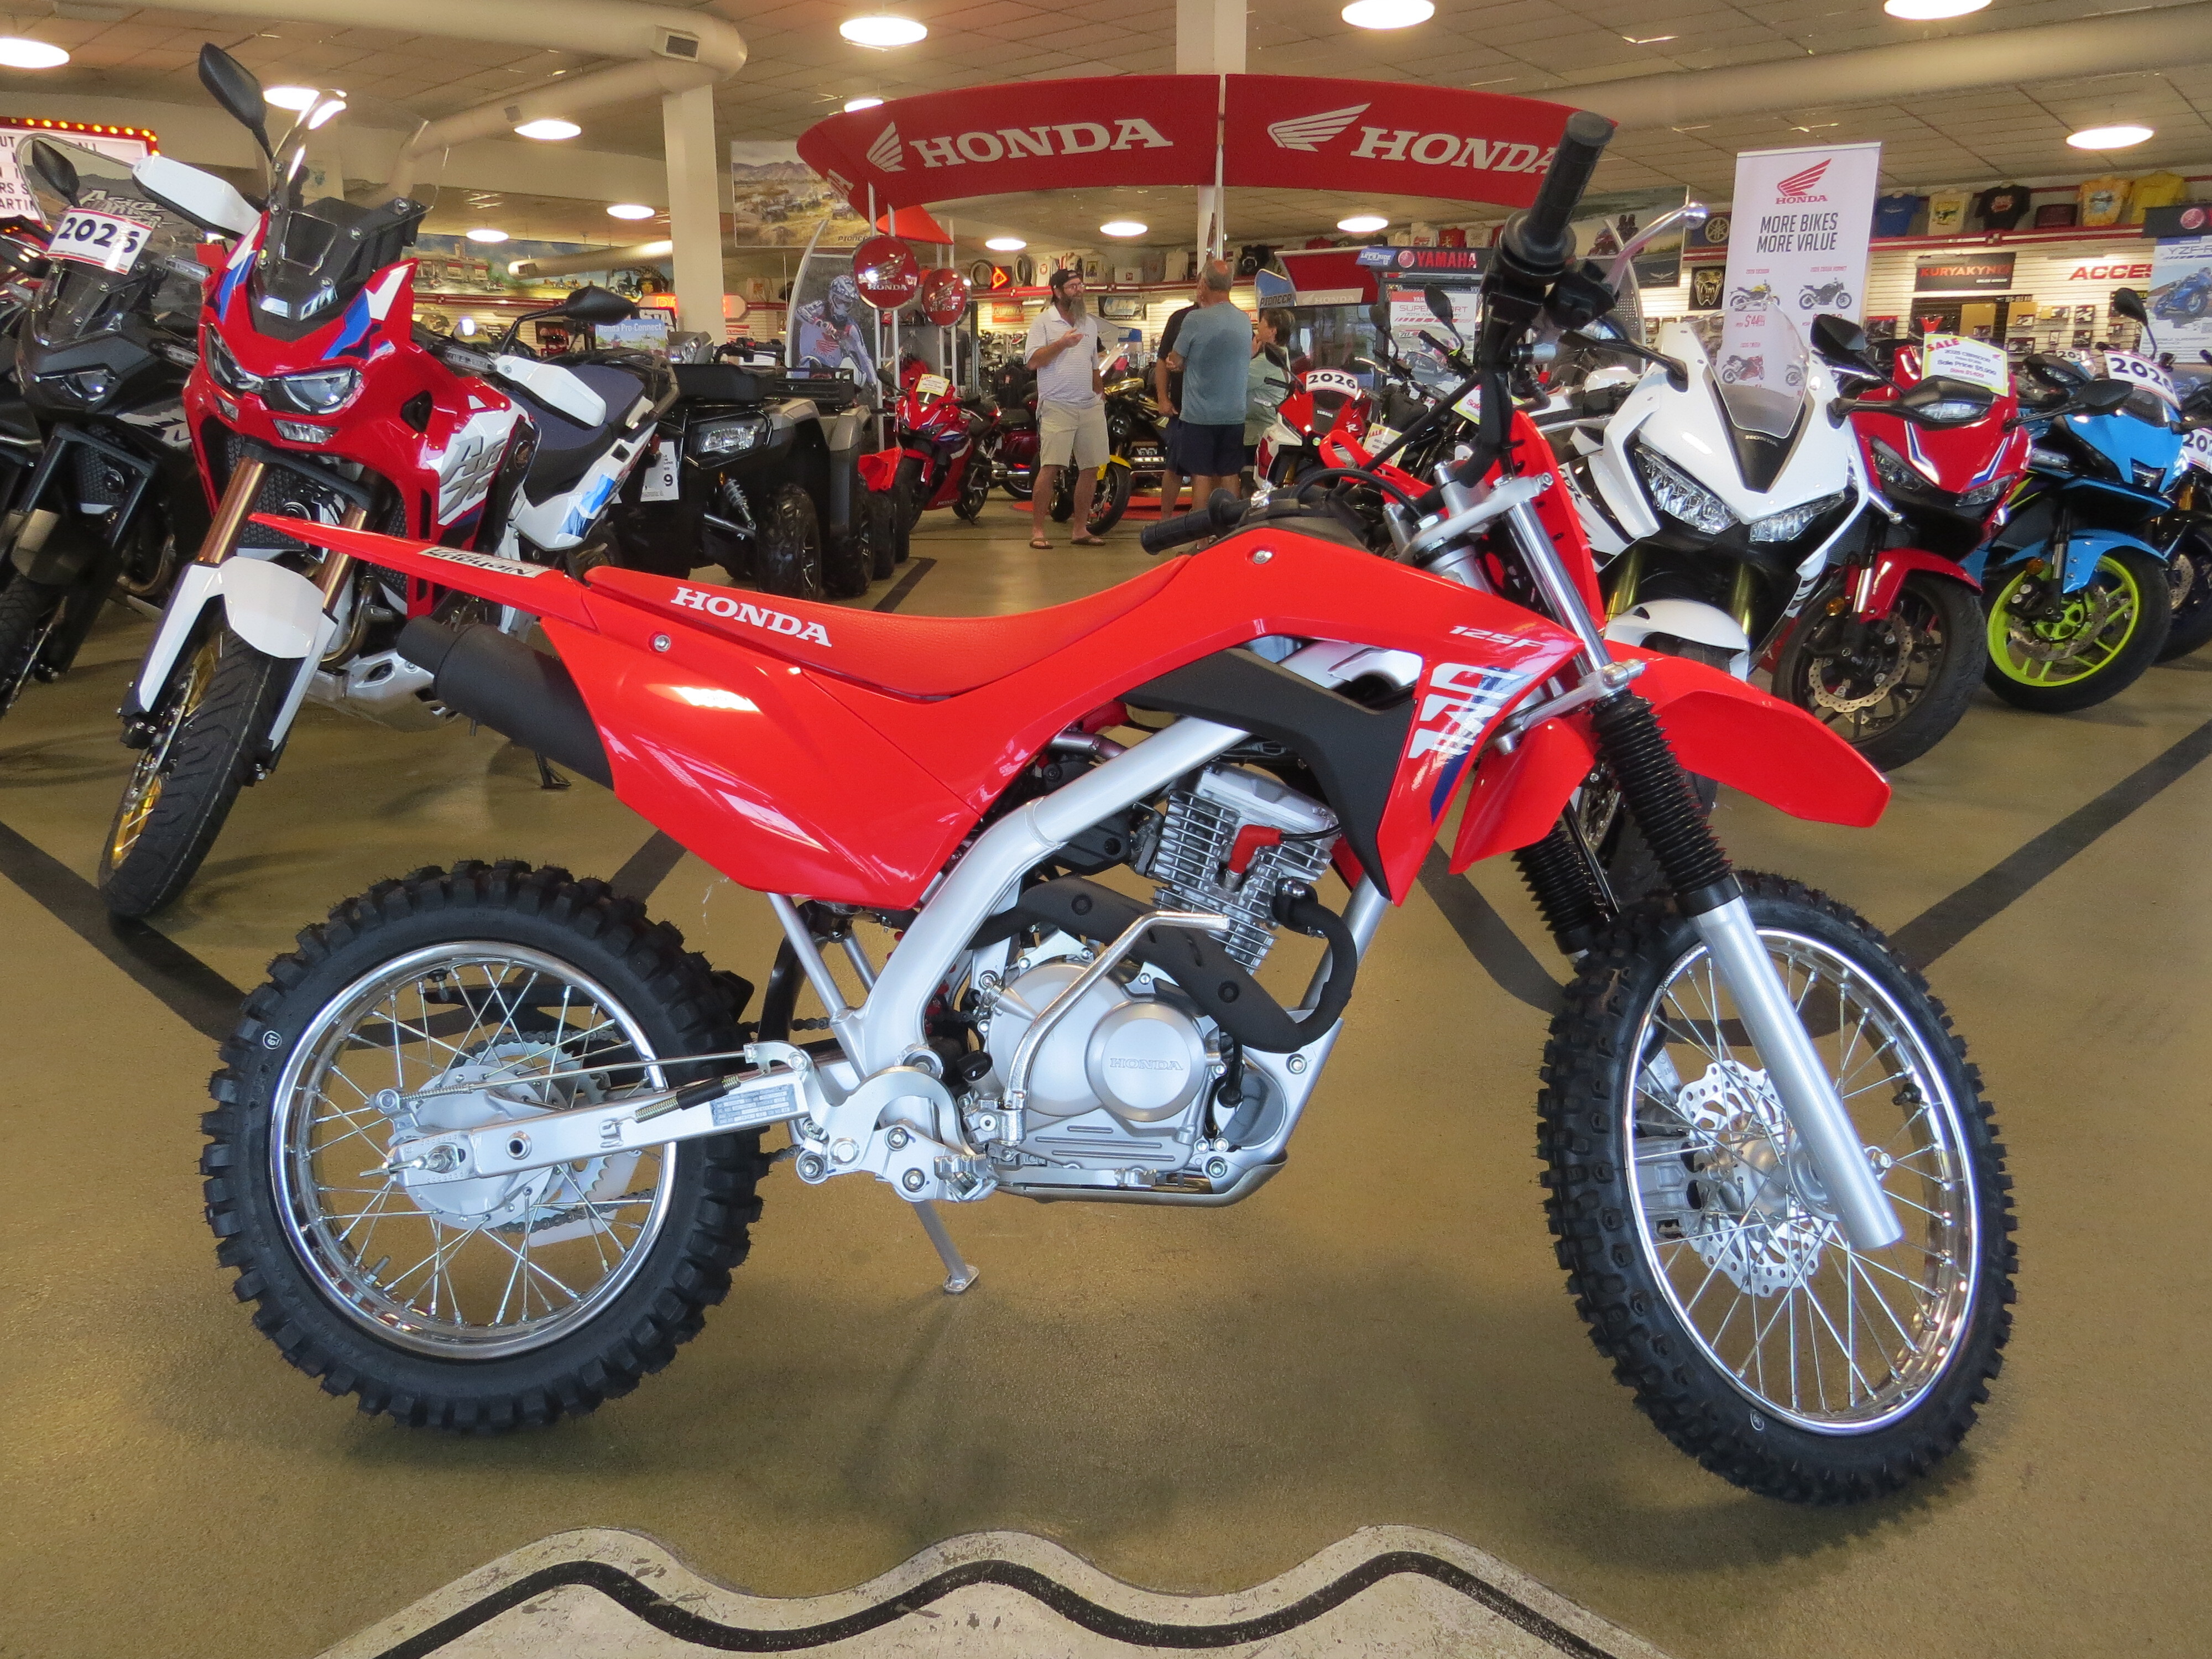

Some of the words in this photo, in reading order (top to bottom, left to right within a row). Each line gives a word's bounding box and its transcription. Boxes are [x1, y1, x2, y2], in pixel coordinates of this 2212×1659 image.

[910, 118, 1173, 168] HONDA
[1775, 195, 1828, 205] HONDA
[1760, 215, 1797, 234] MORE
[1799, 212, 1839, 232] BIKES
[1756, 234, 1793, 253] MORE
[1797, 232, 1838, 252] VALUE
[1417, 251, 1477, 269] YAMAHA
[1260, 293, 1292, 307] PIONEER
[1314, 295, 1355, 304] HONDA
[1926, 337, 1960, 352] SALE
[1308, 373, 1356, 389] 2026
[1317, 409, 1333, 419] YAMAHA
[1745, 435, 1779, 447] HONDA
[670, 586, 832, 647] HONDA
[1449, 625, 1550, 648] 125F
[1109, 1057, 1183, 1071] HONDA
